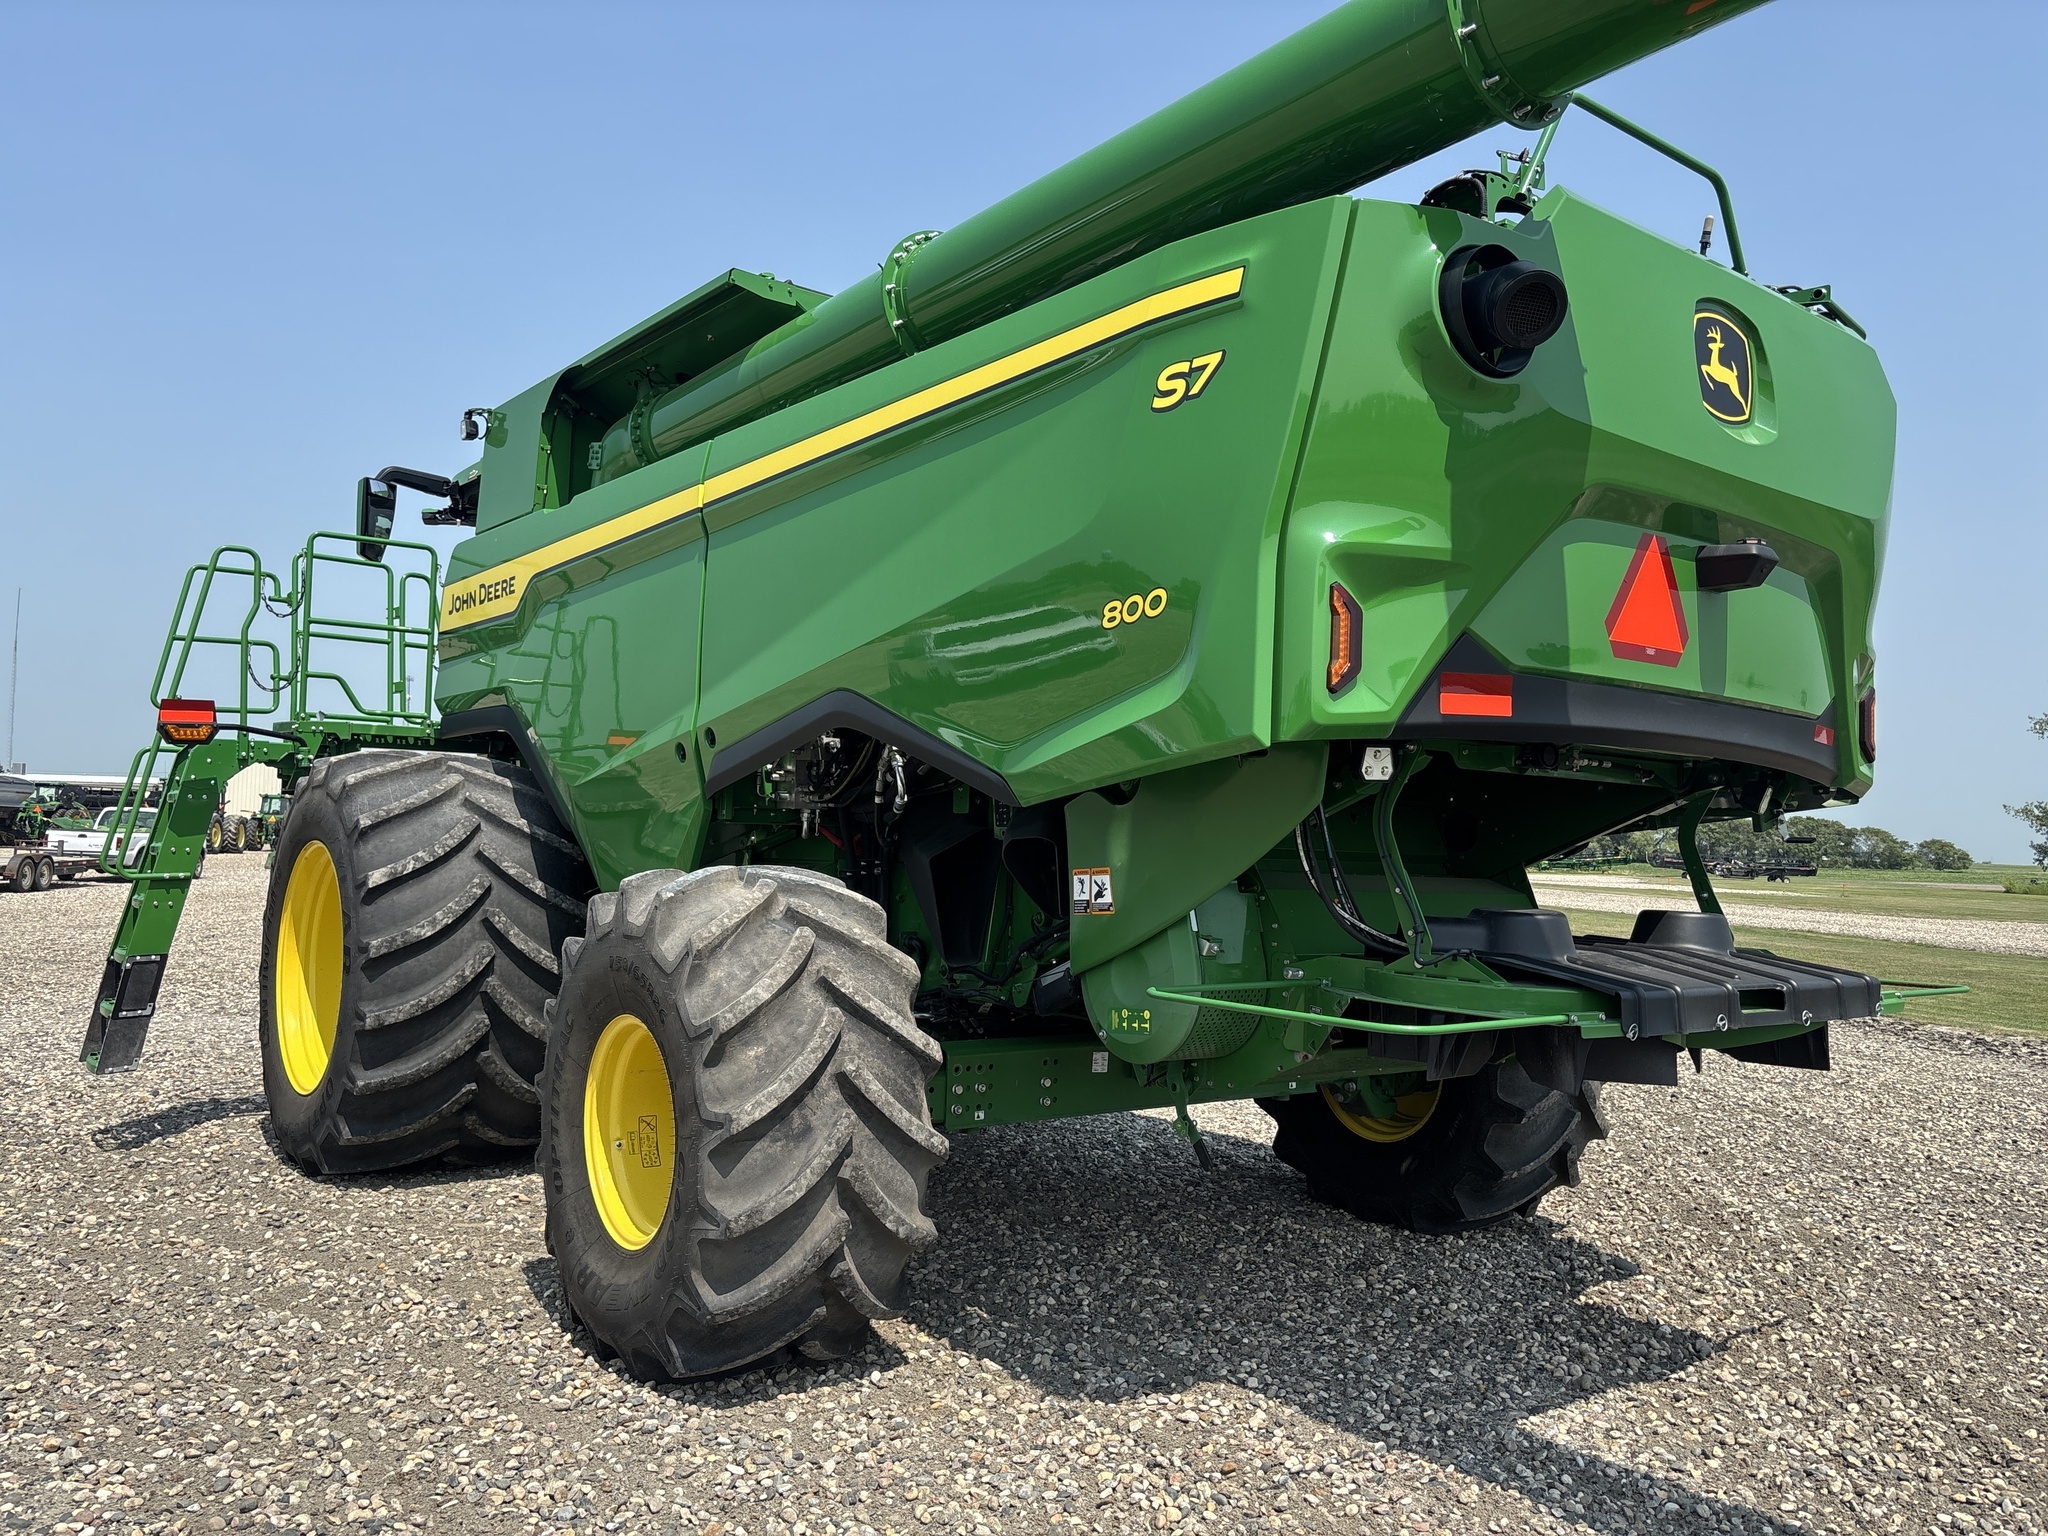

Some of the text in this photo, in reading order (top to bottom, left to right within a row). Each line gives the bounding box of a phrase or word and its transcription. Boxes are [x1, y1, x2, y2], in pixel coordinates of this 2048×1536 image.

[1150, 349, 1226, 413] S7
[448, 576, 516, 615] JOHN DEERE
[1101, 587, 1168, 630] 800
